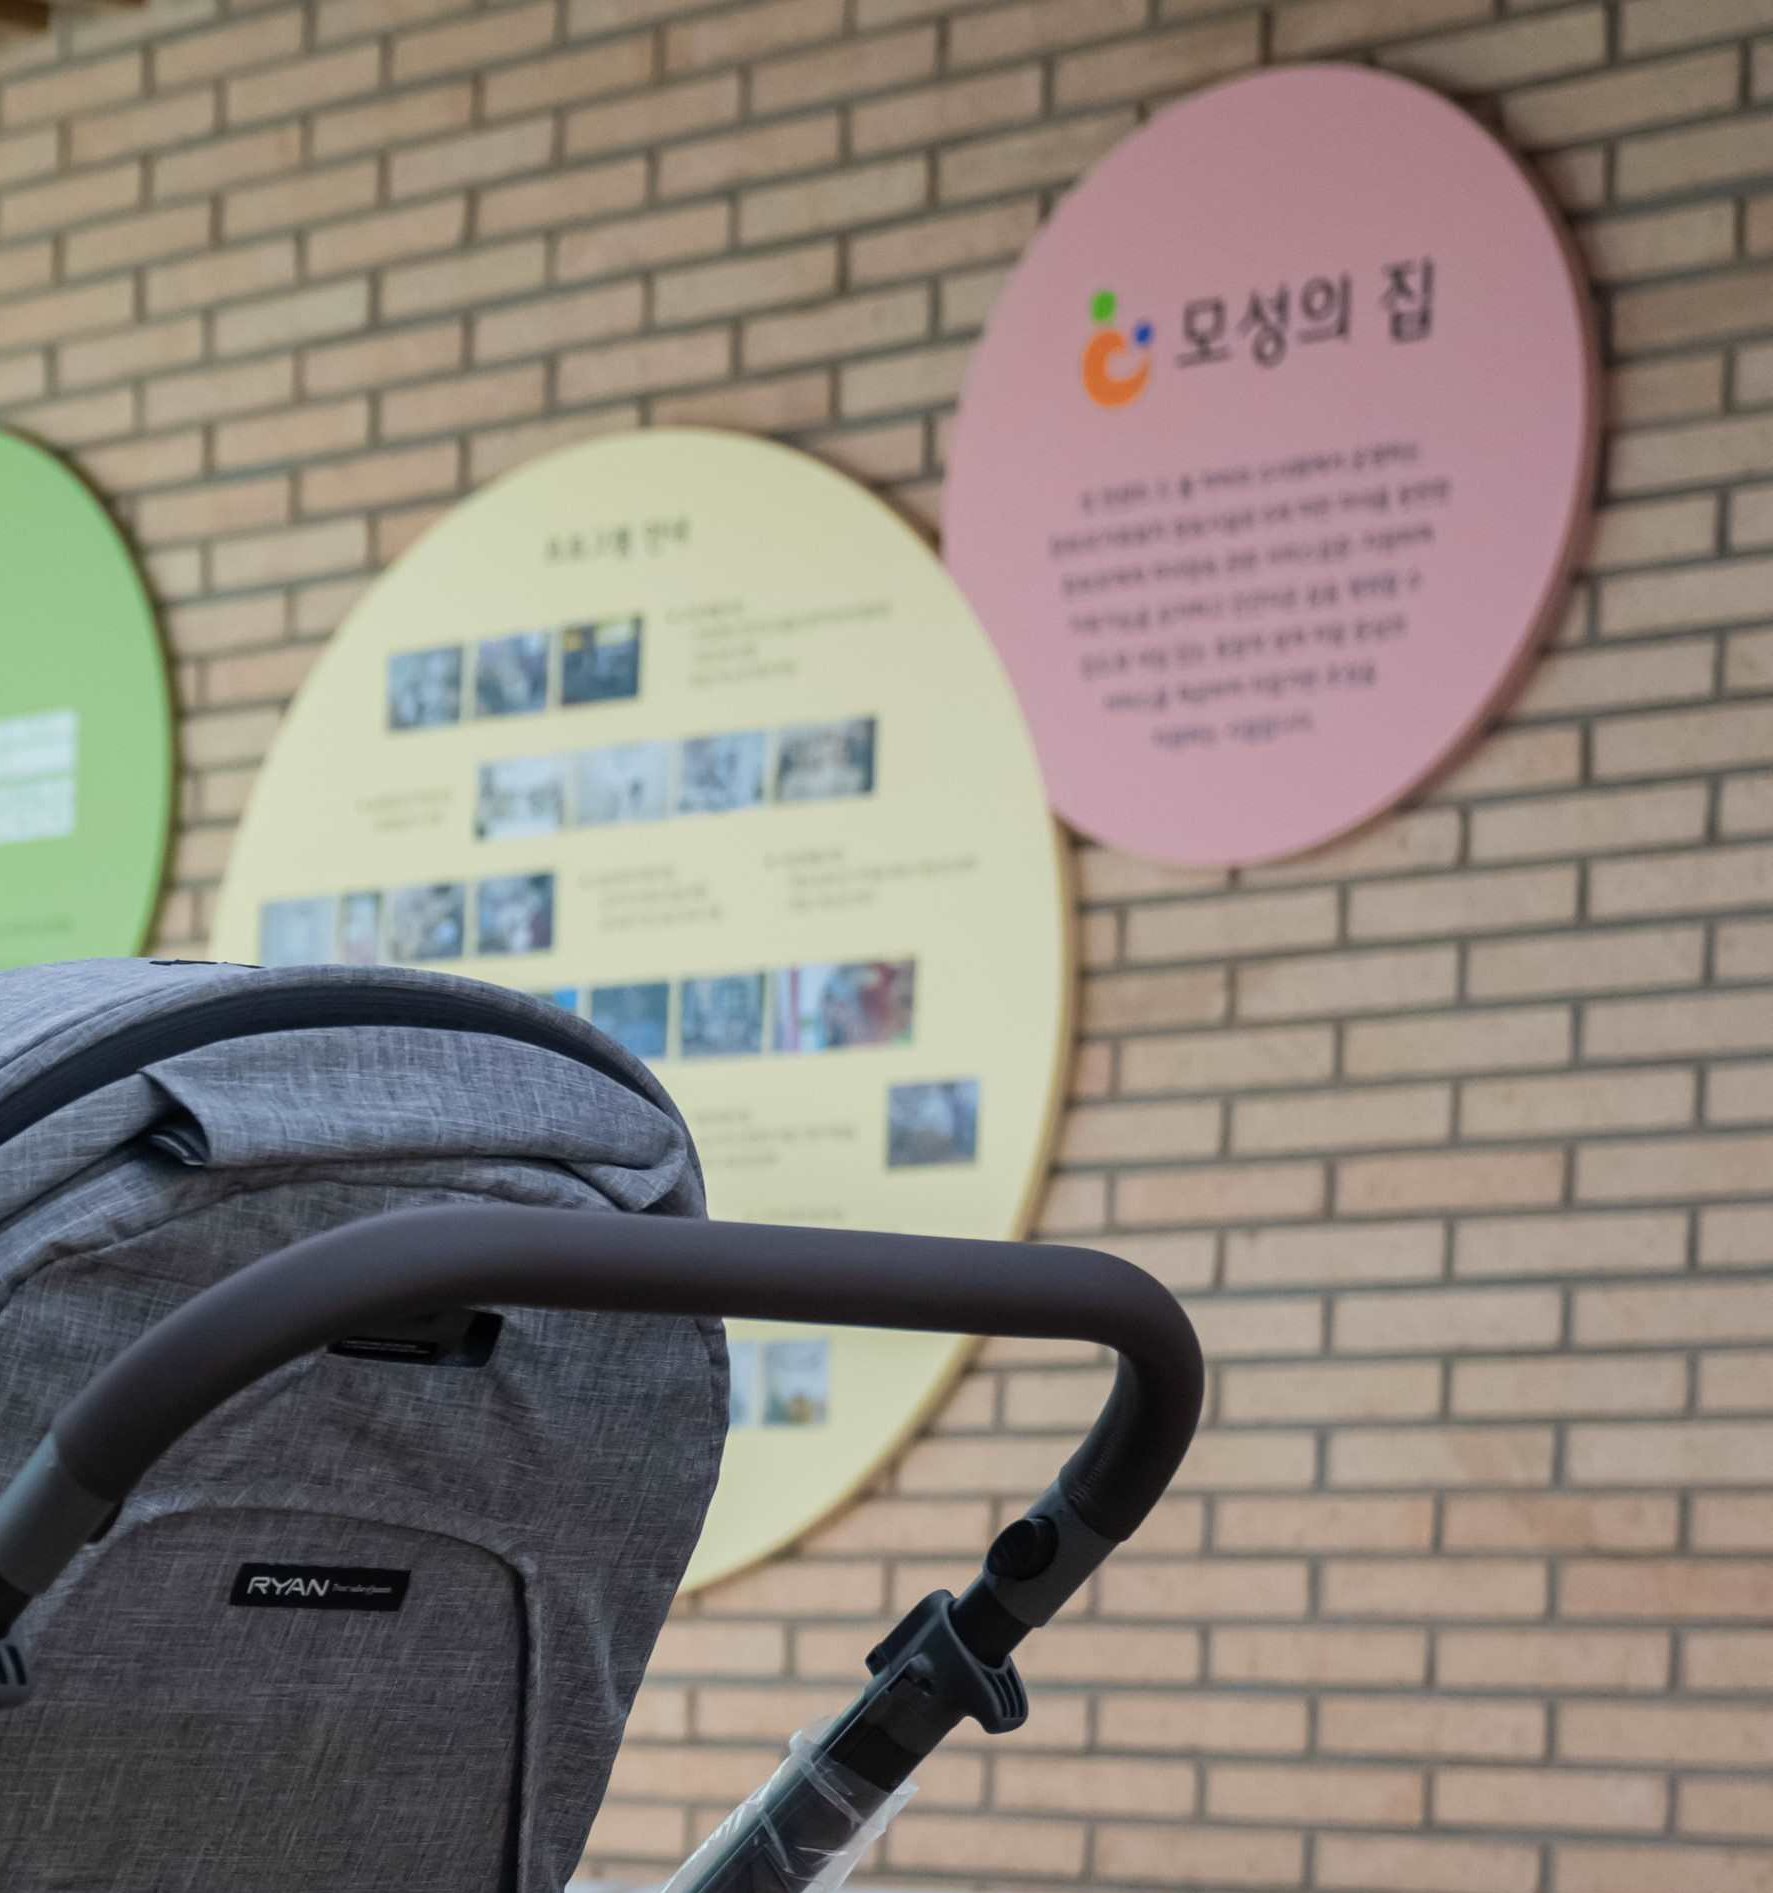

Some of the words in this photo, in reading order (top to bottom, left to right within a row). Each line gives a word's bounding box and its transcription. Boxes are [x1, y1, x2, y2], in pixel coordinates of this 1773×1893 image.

[1175, 269, 1351, 369] 모성의
[1379, 255, 1435, 345] 집
[246, 1576, 330, 1598] RYAN
